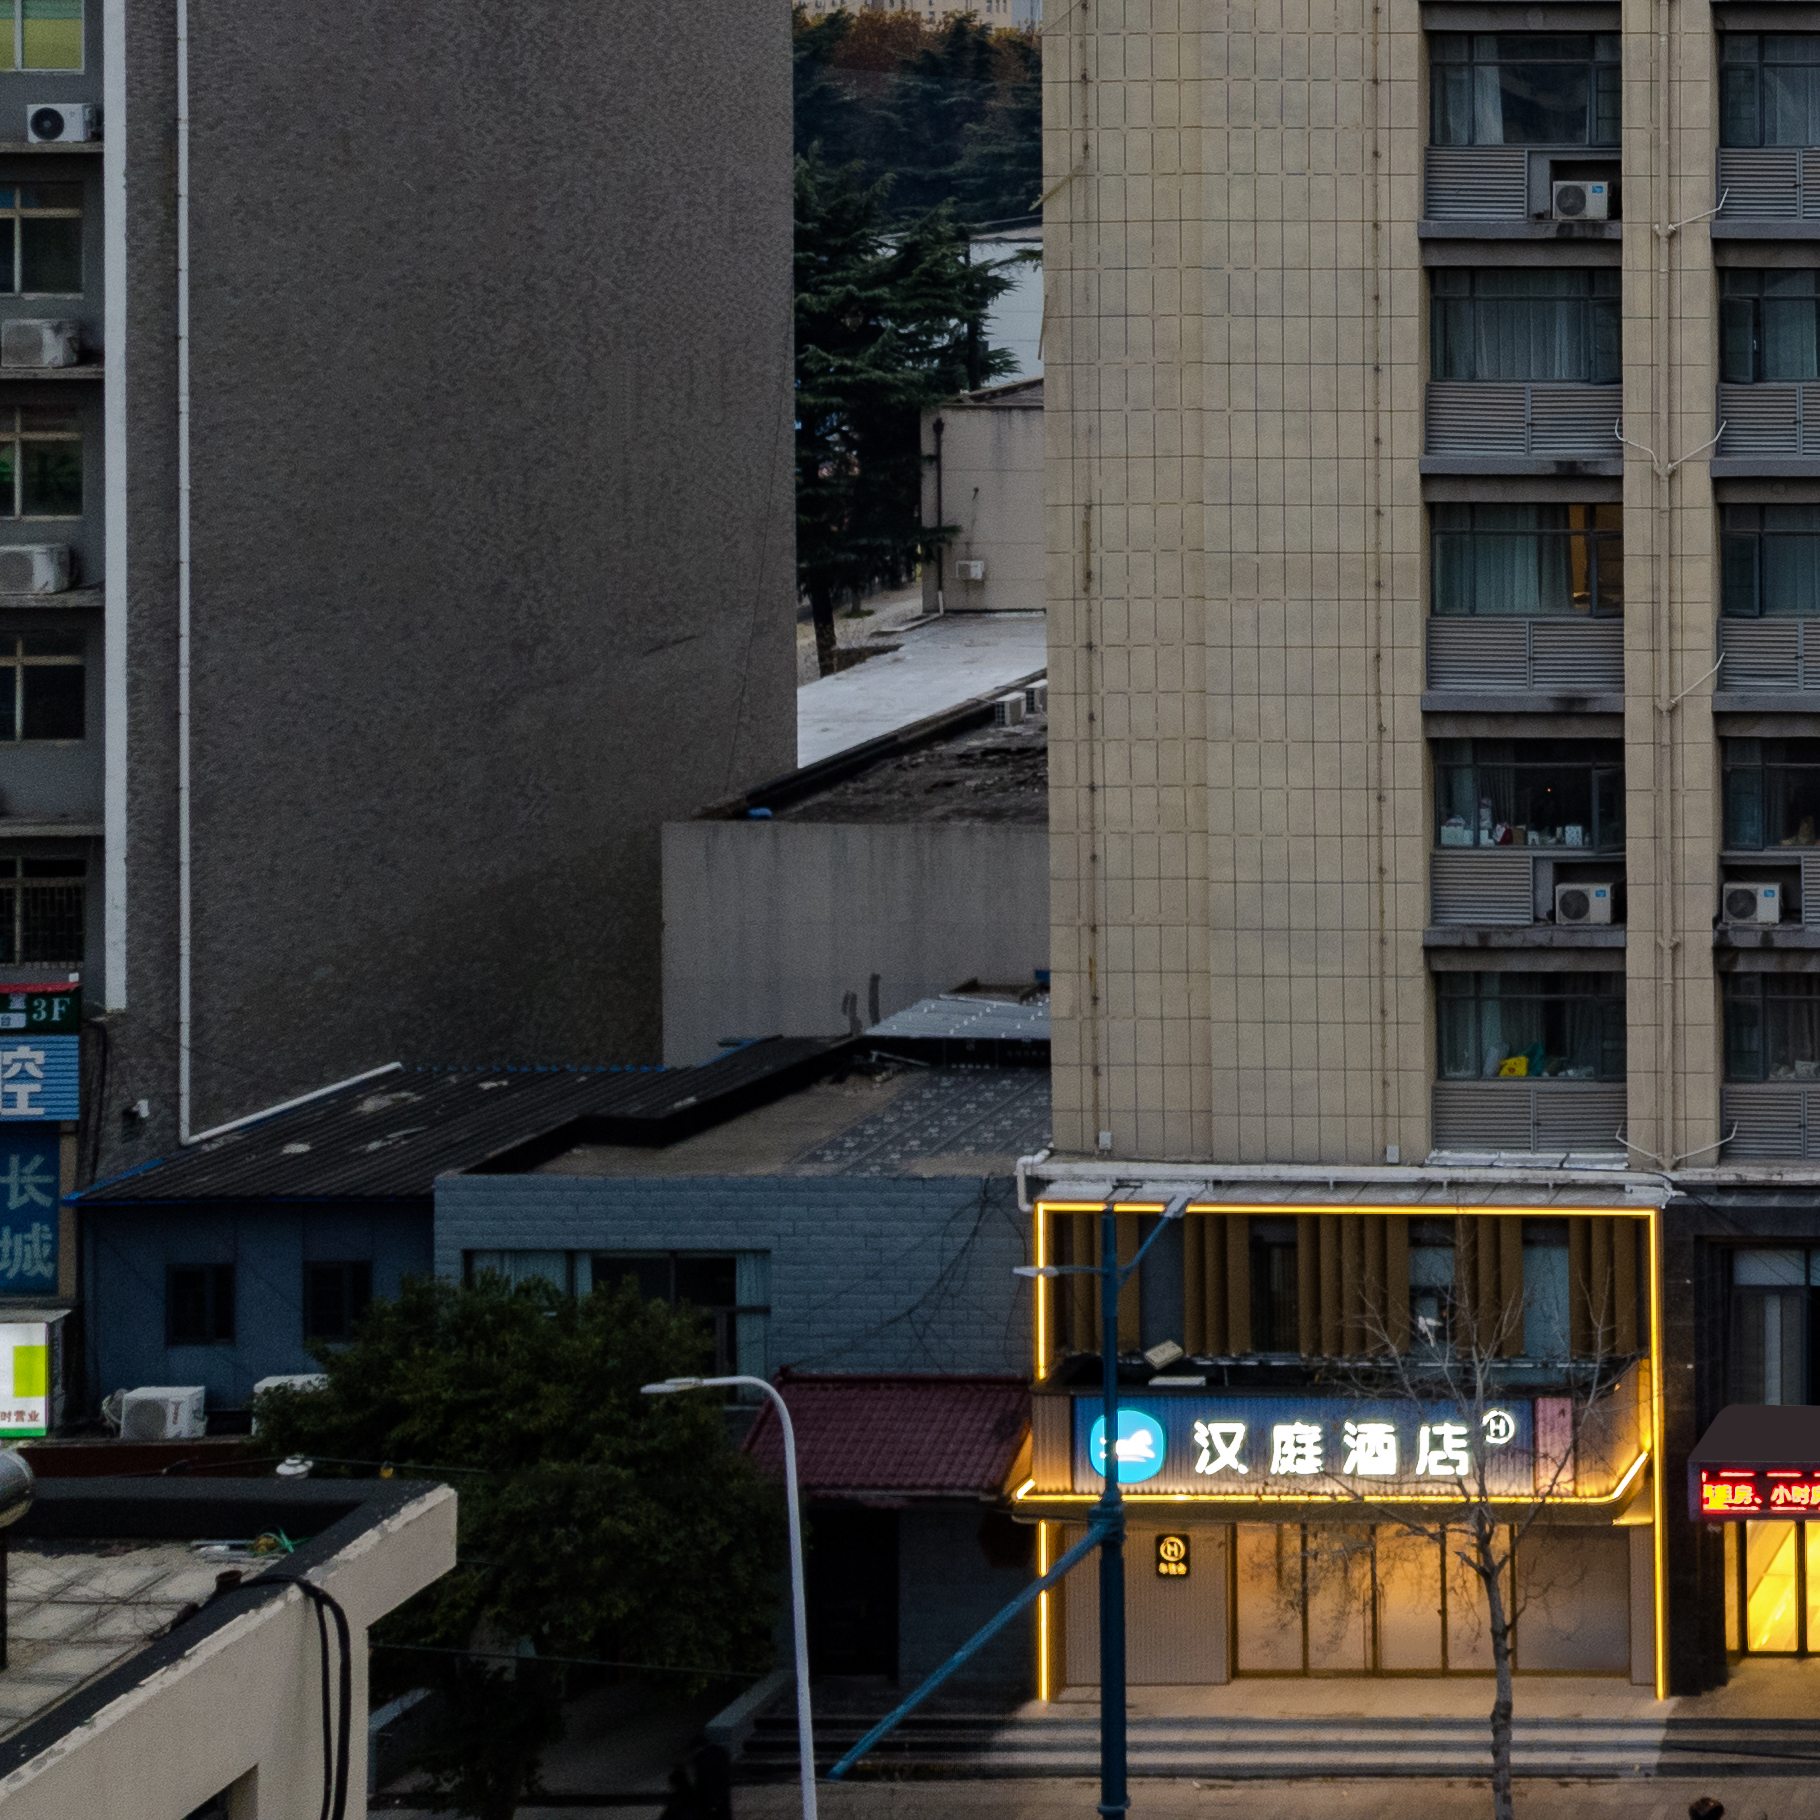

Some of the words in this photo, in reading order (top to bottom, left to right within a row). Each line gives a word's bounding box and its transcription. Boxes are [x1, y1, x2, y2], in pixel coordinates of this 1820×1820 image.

[32, 997, 70, 1021] 3F
[1193, 1419, 1471, 1477] 汉庭酒店
